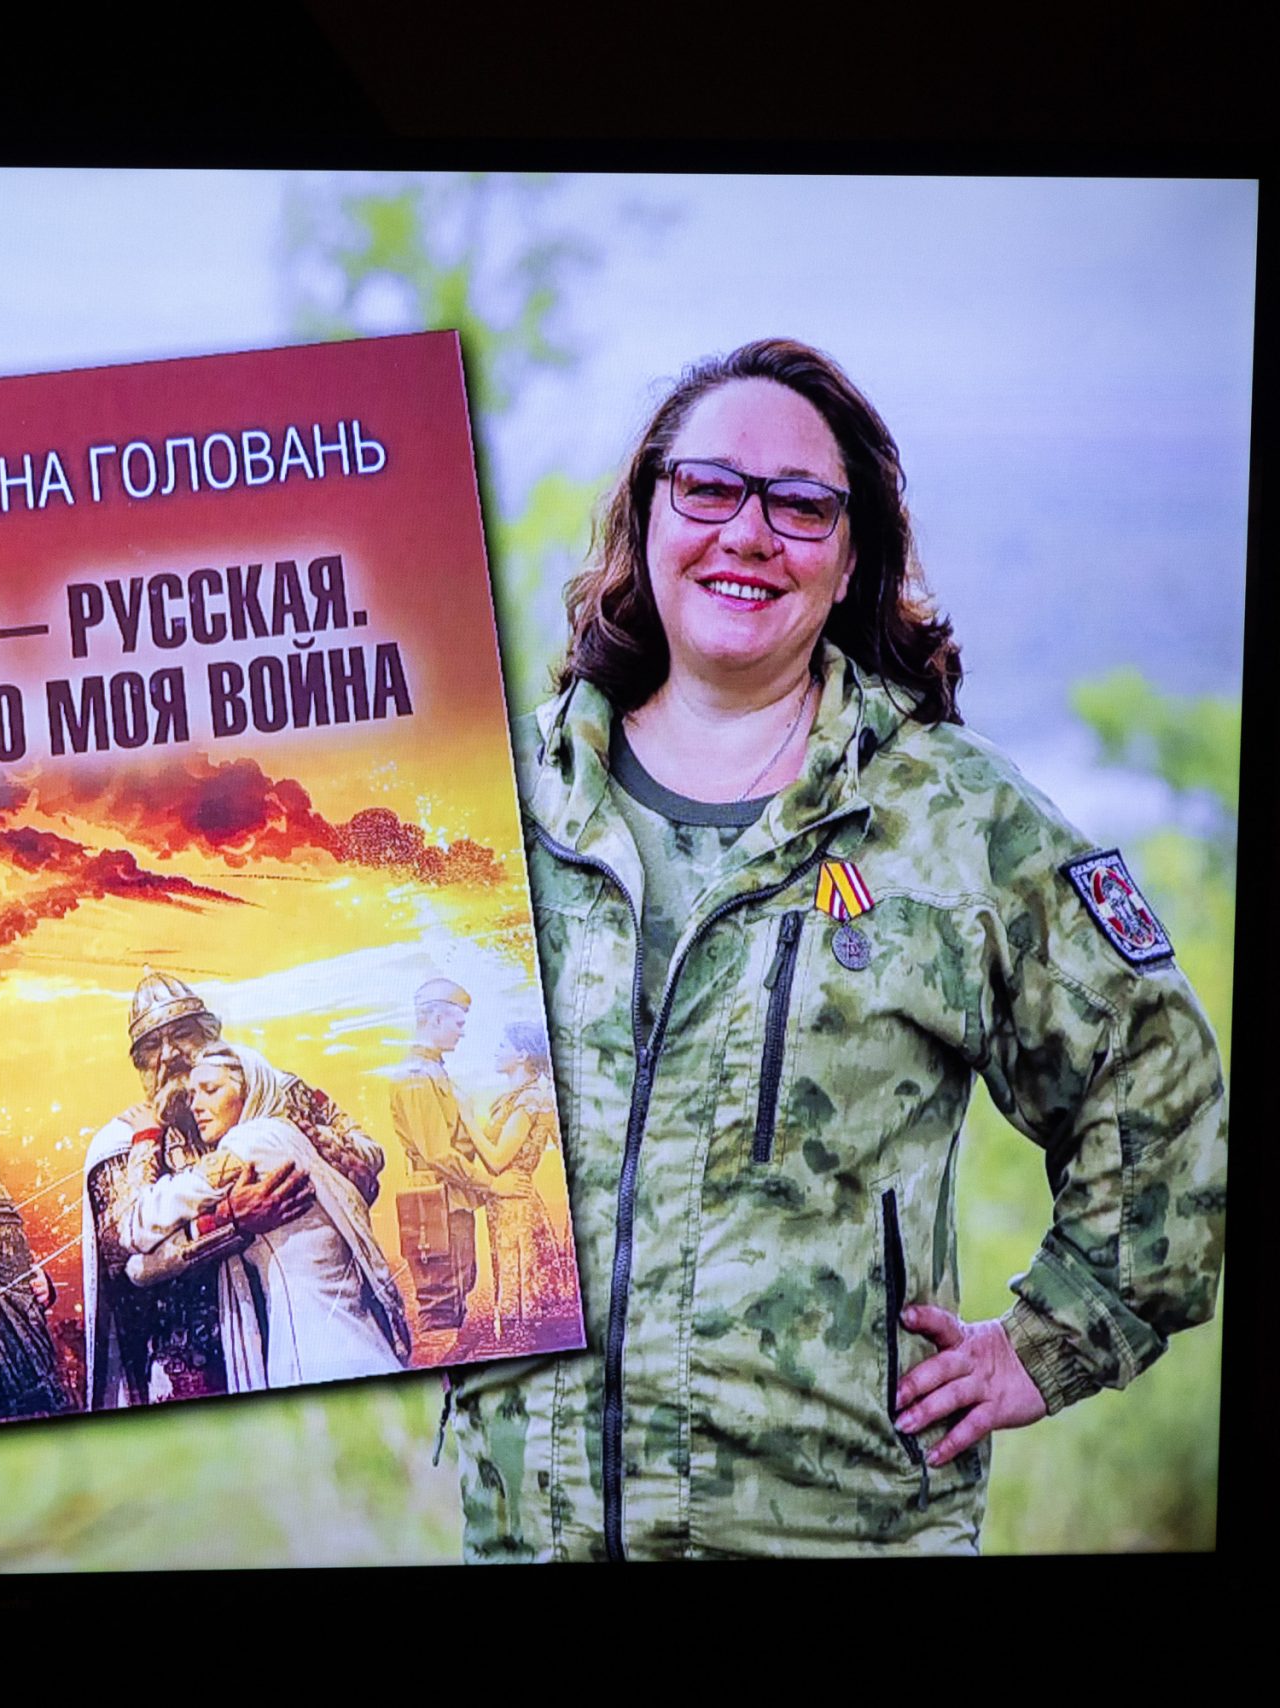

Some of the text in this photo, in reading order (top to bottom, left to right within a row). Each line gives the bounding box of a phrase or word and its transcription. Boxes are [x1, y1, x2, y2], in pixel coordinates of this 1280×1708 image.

[89, 420, 386, 502] ГОЛОВАНЬ
[66, 555, 368, 659] РУССКАЯ.
[46, 666, 189, 756] МОЯ
[208, 637, 413, 739] ВОЙНА
